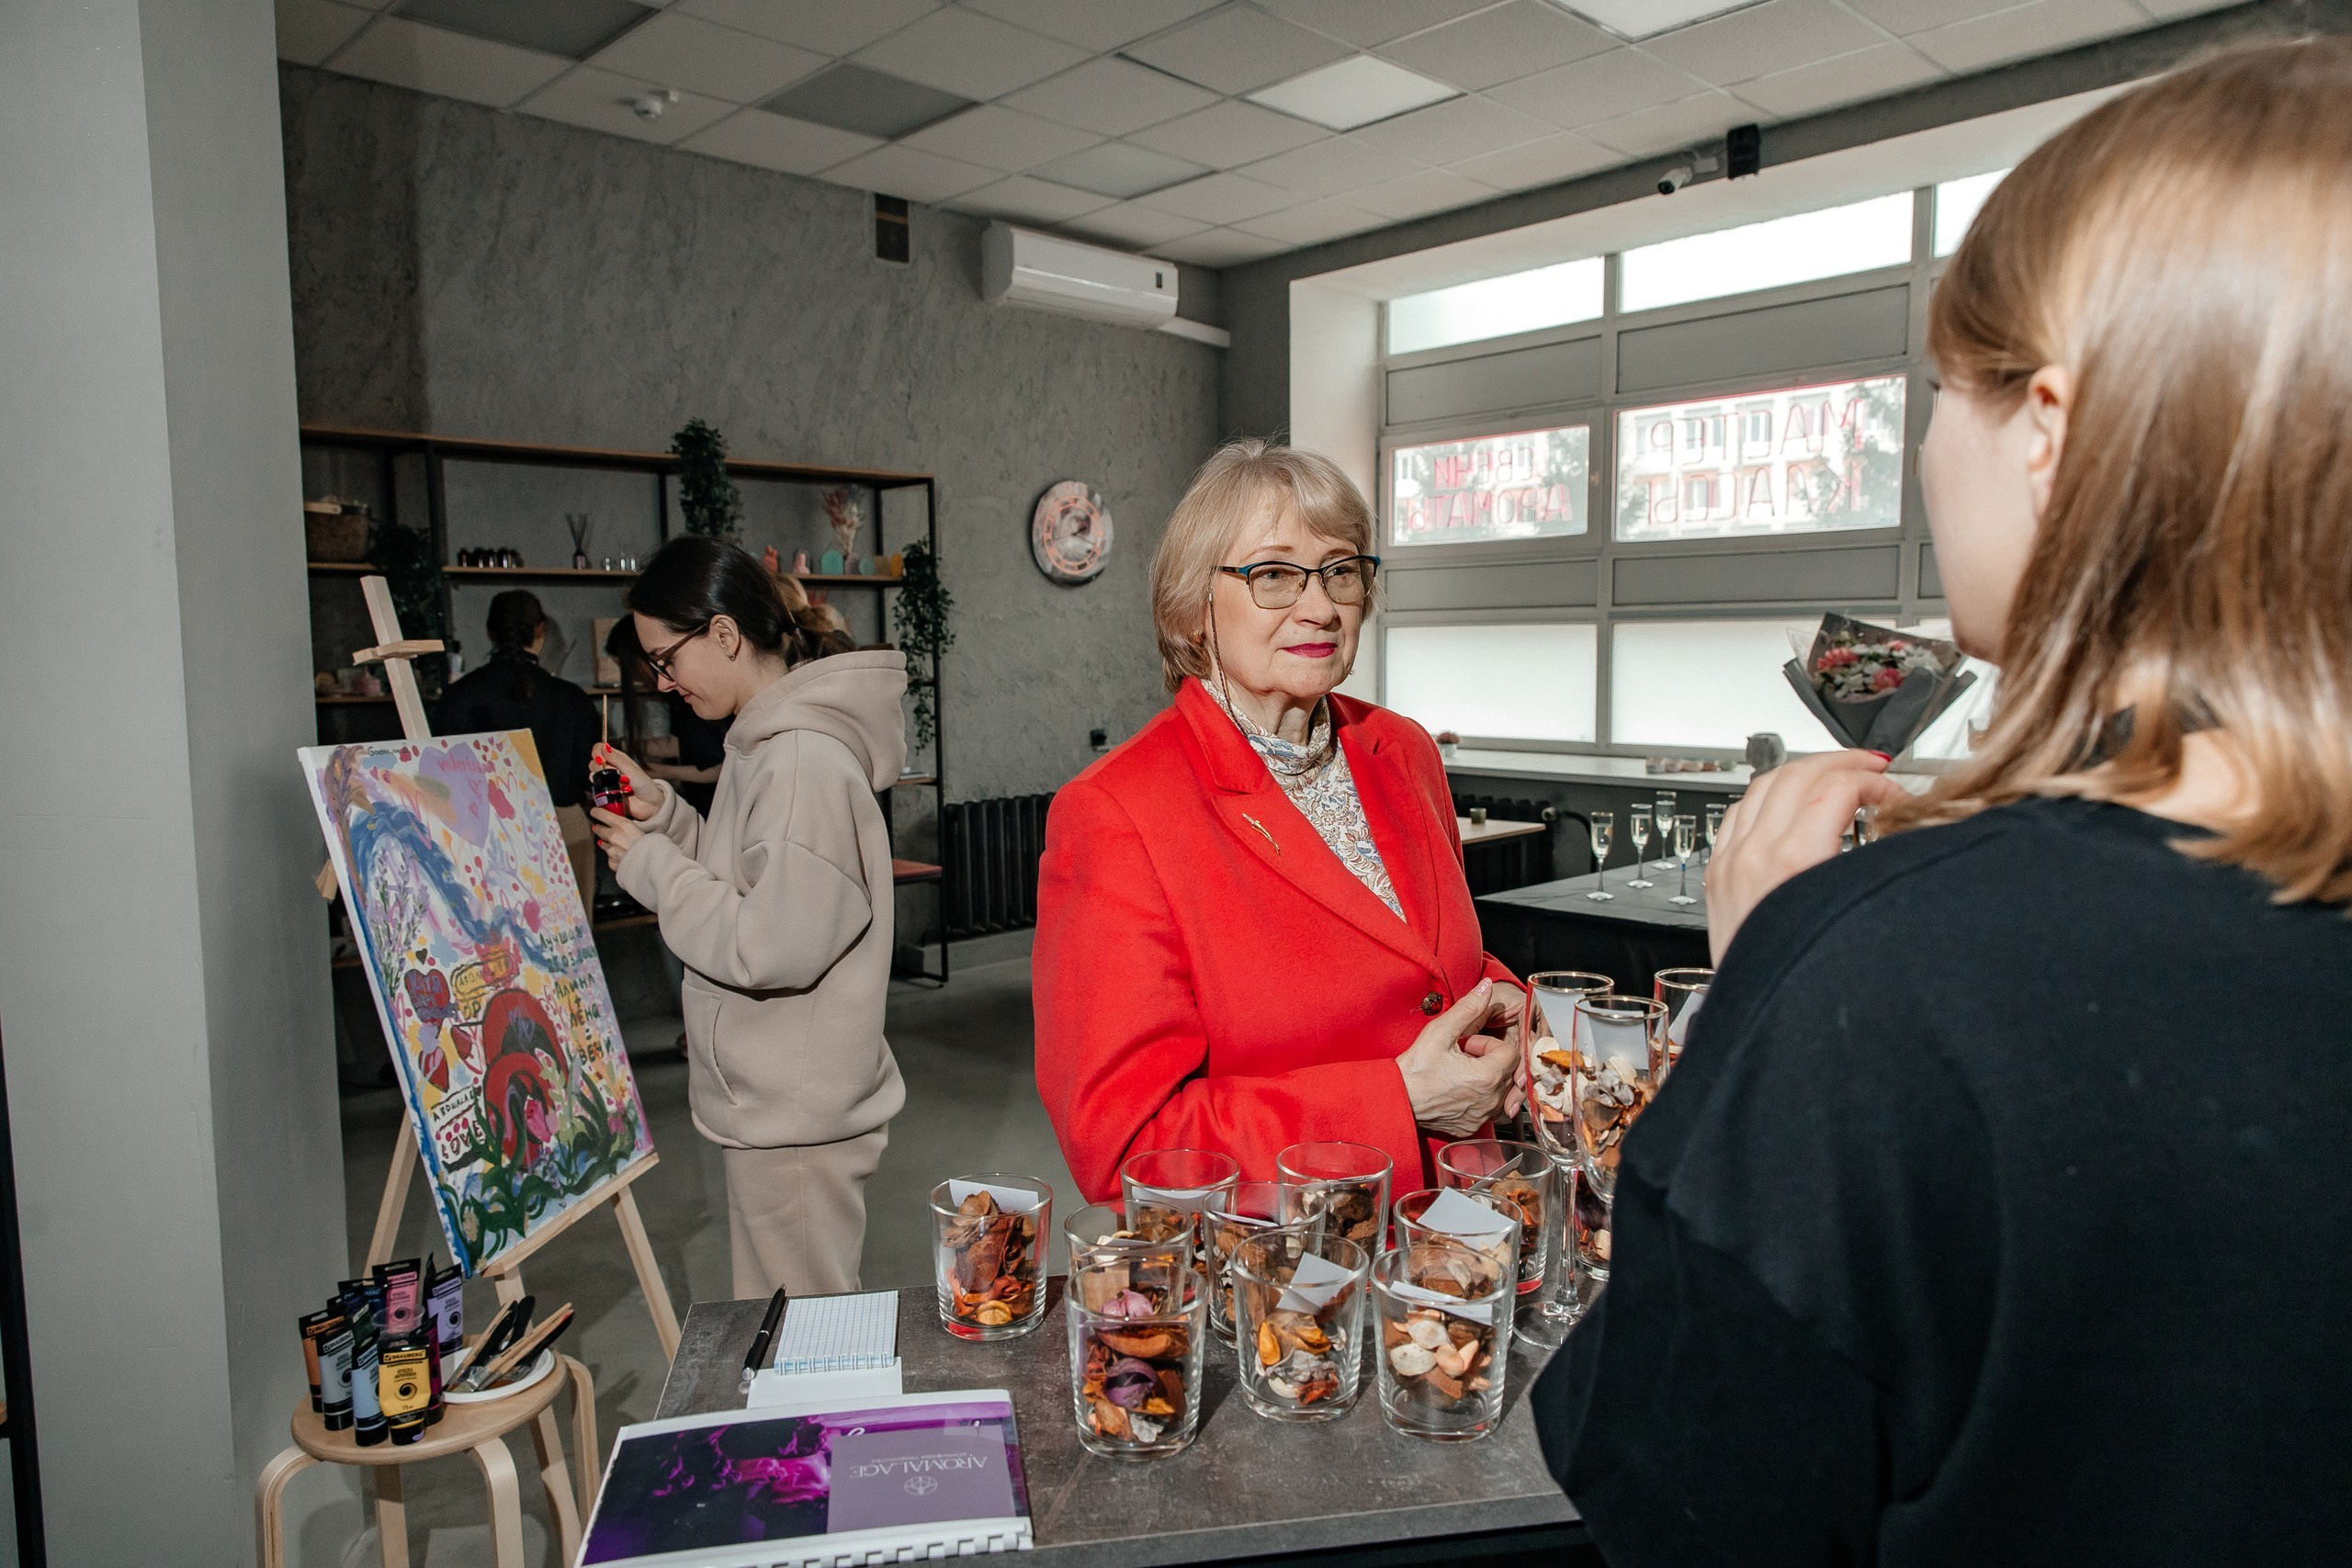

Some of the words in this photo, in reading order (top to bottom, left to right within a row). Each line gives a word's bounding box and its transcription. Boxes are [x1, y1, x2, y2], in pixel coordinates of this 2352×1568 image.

[441, 1120, 484, 1158] LOVE
[392, 1351, 424, 1360] BRAUBERG
[849, 1456, 989, 1479] AROMALAGE
